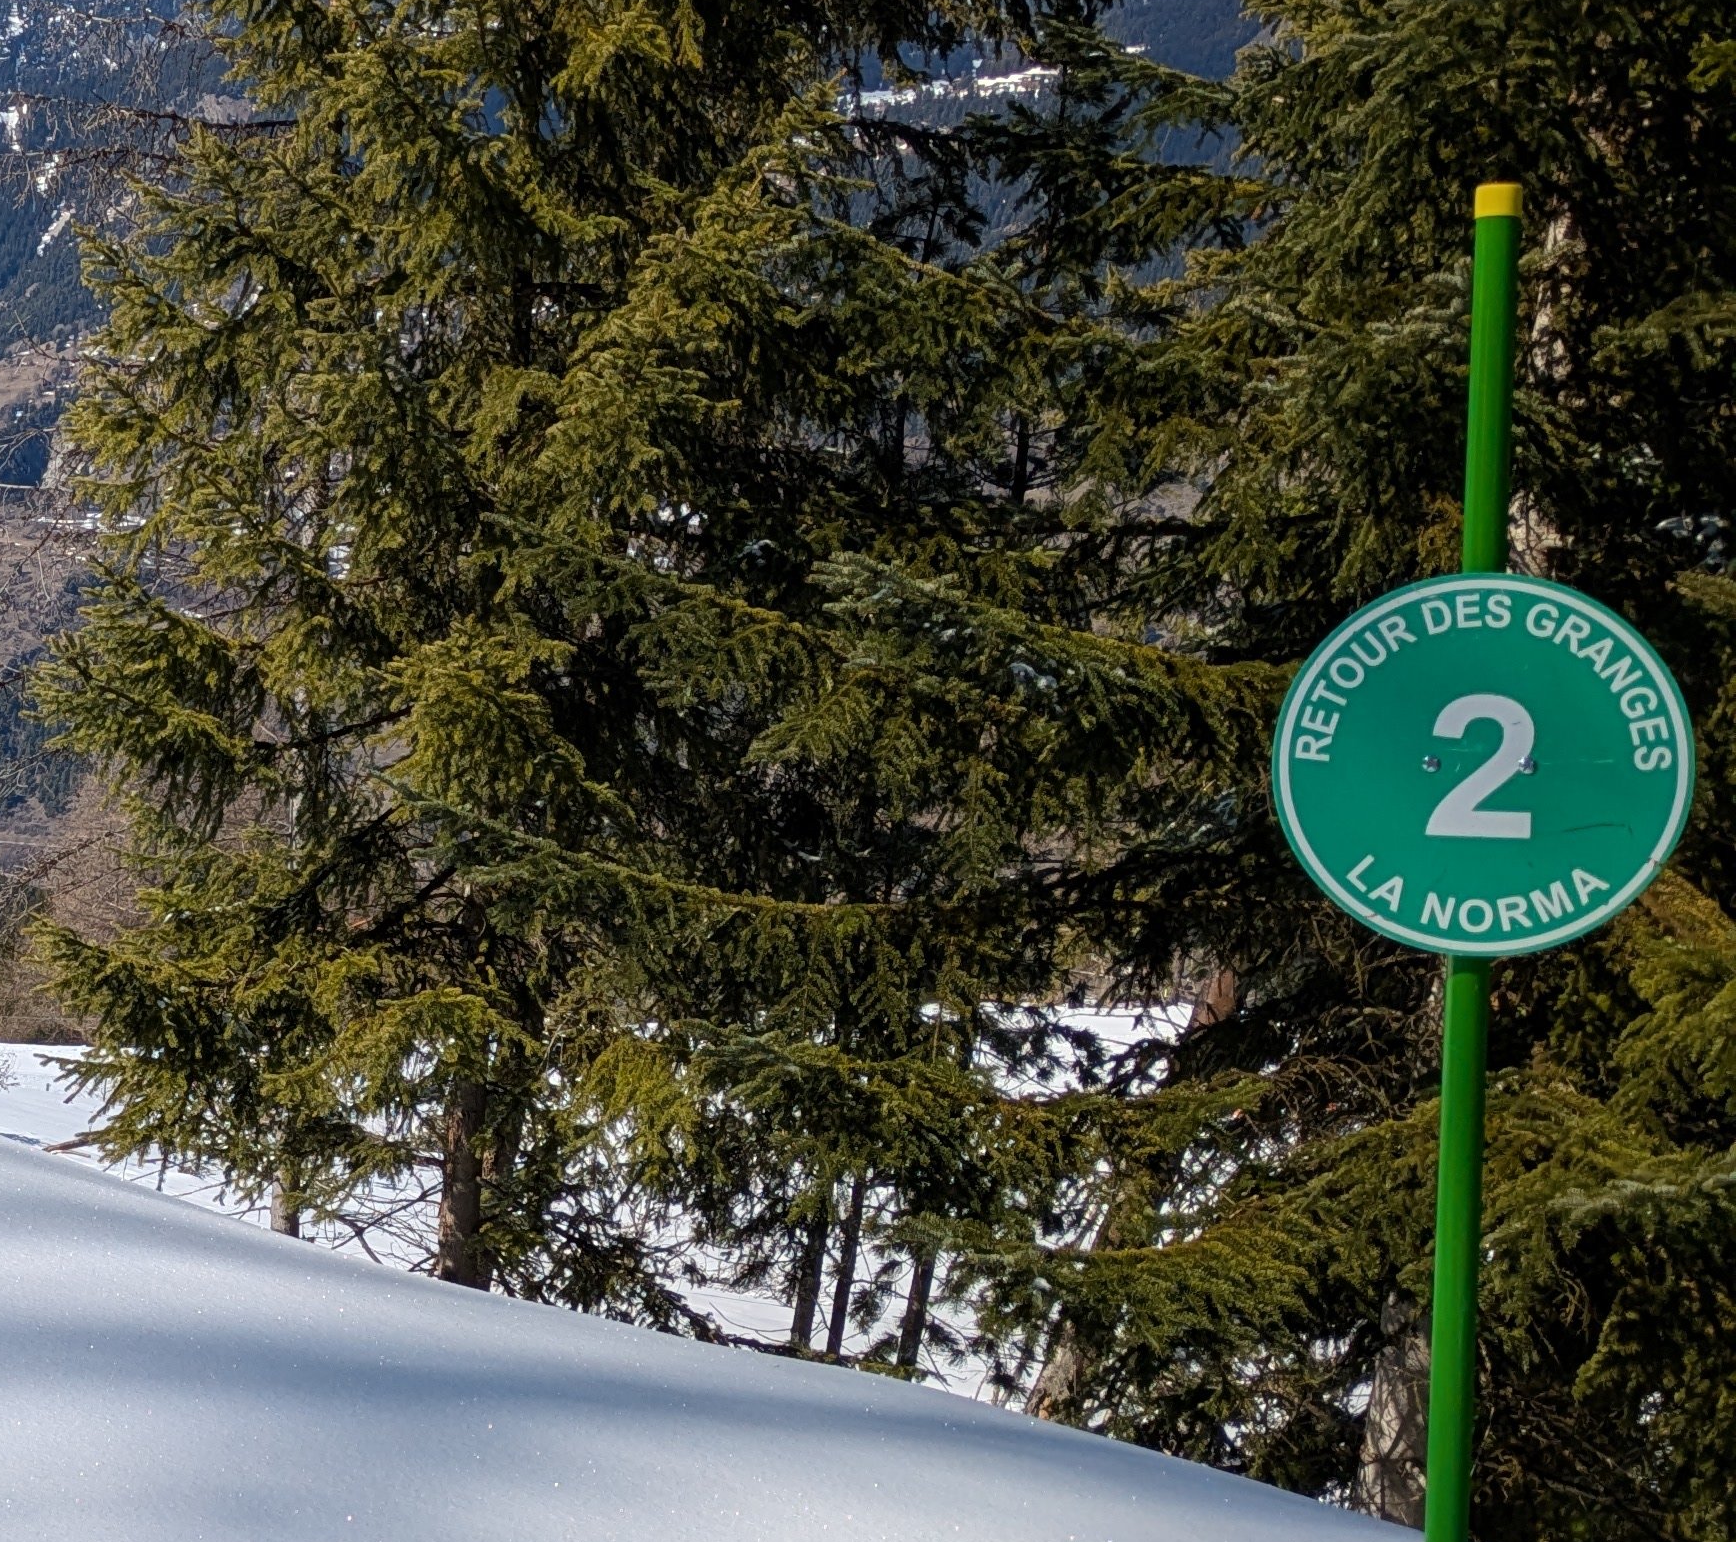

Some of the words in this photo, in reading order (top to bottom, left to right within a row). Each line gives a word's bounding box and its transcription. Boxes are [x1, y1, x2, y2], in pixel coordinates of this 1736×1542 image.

[1295, 615, 1417, 762] RETOUR
[1421, 593, 1512, 636] DES
[1525, 602, 1672, 772] GRANGES
[1425, 693, 1535, 839] 2
[1346, 854, 1404, 912] LA
[1420, 868, 1610, 933] NORMA
